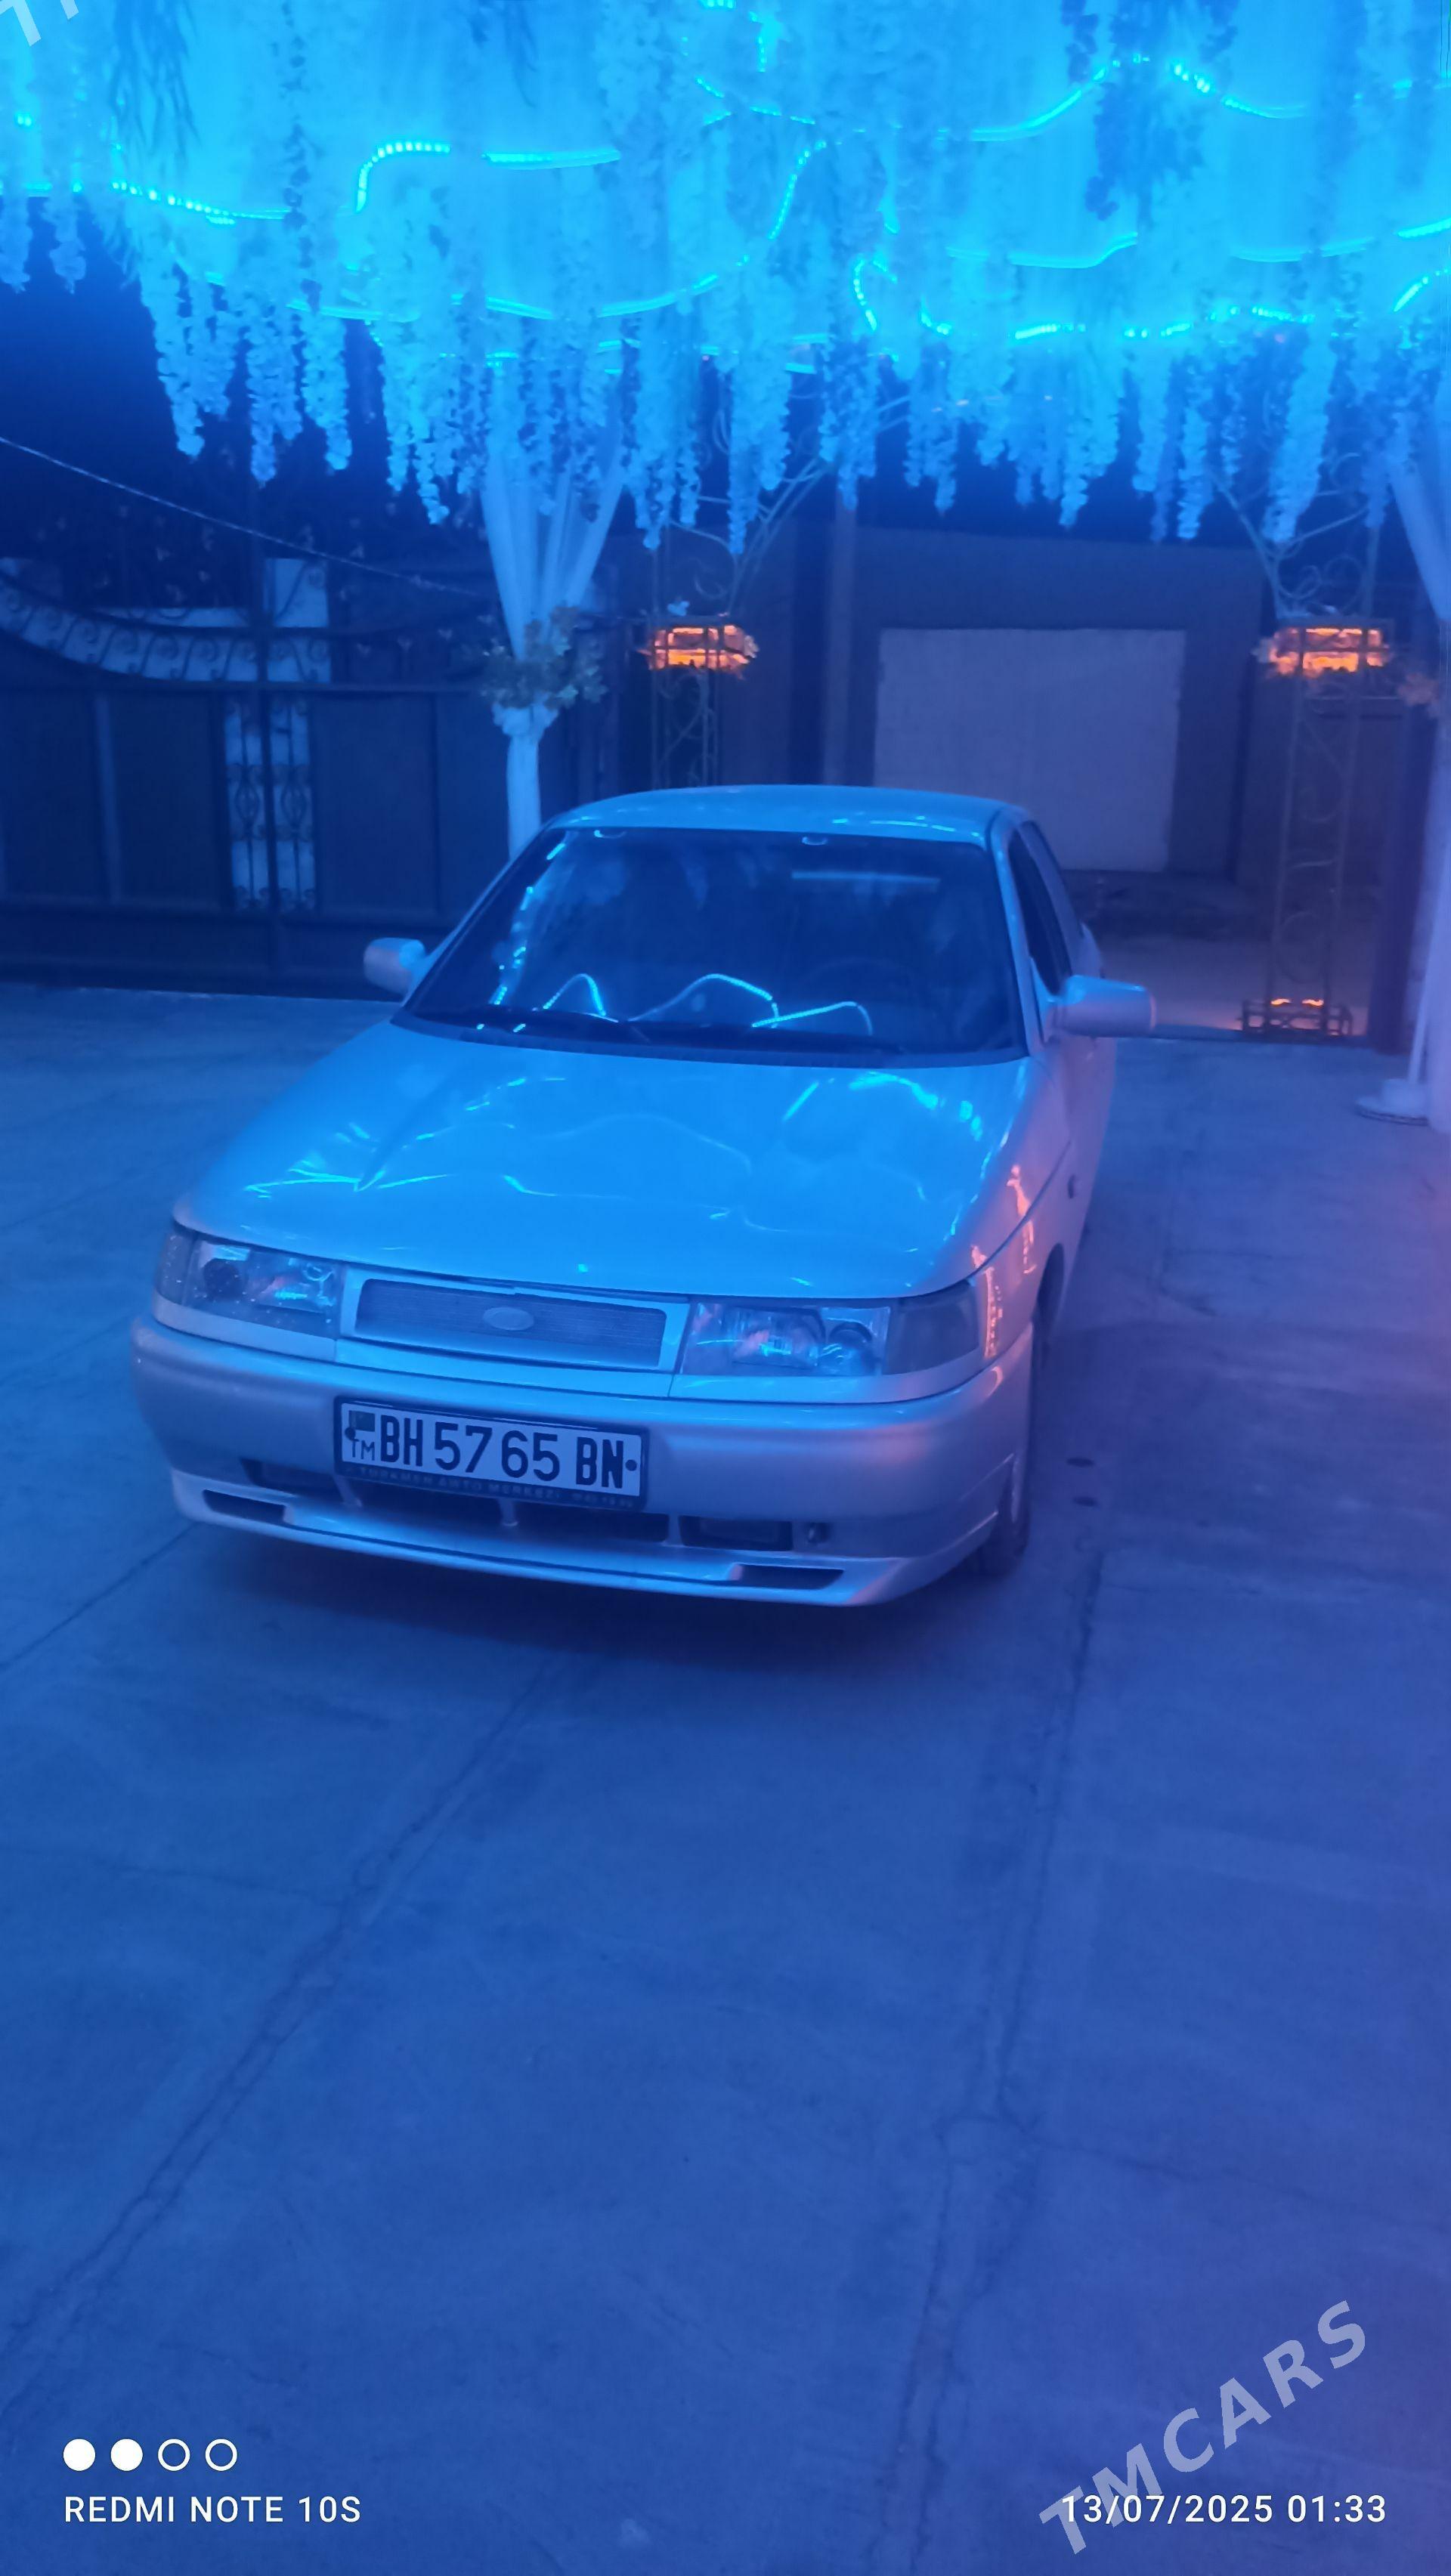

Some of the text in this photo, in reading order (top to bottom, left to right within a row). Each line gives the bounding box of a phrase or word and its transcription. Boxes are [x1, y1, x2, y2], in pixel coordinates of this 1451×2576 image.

[349, 1437, 376, 1461] TM
[380, 1415, 423, 1467] BH
[575, 1436, 623, 1489] BN
